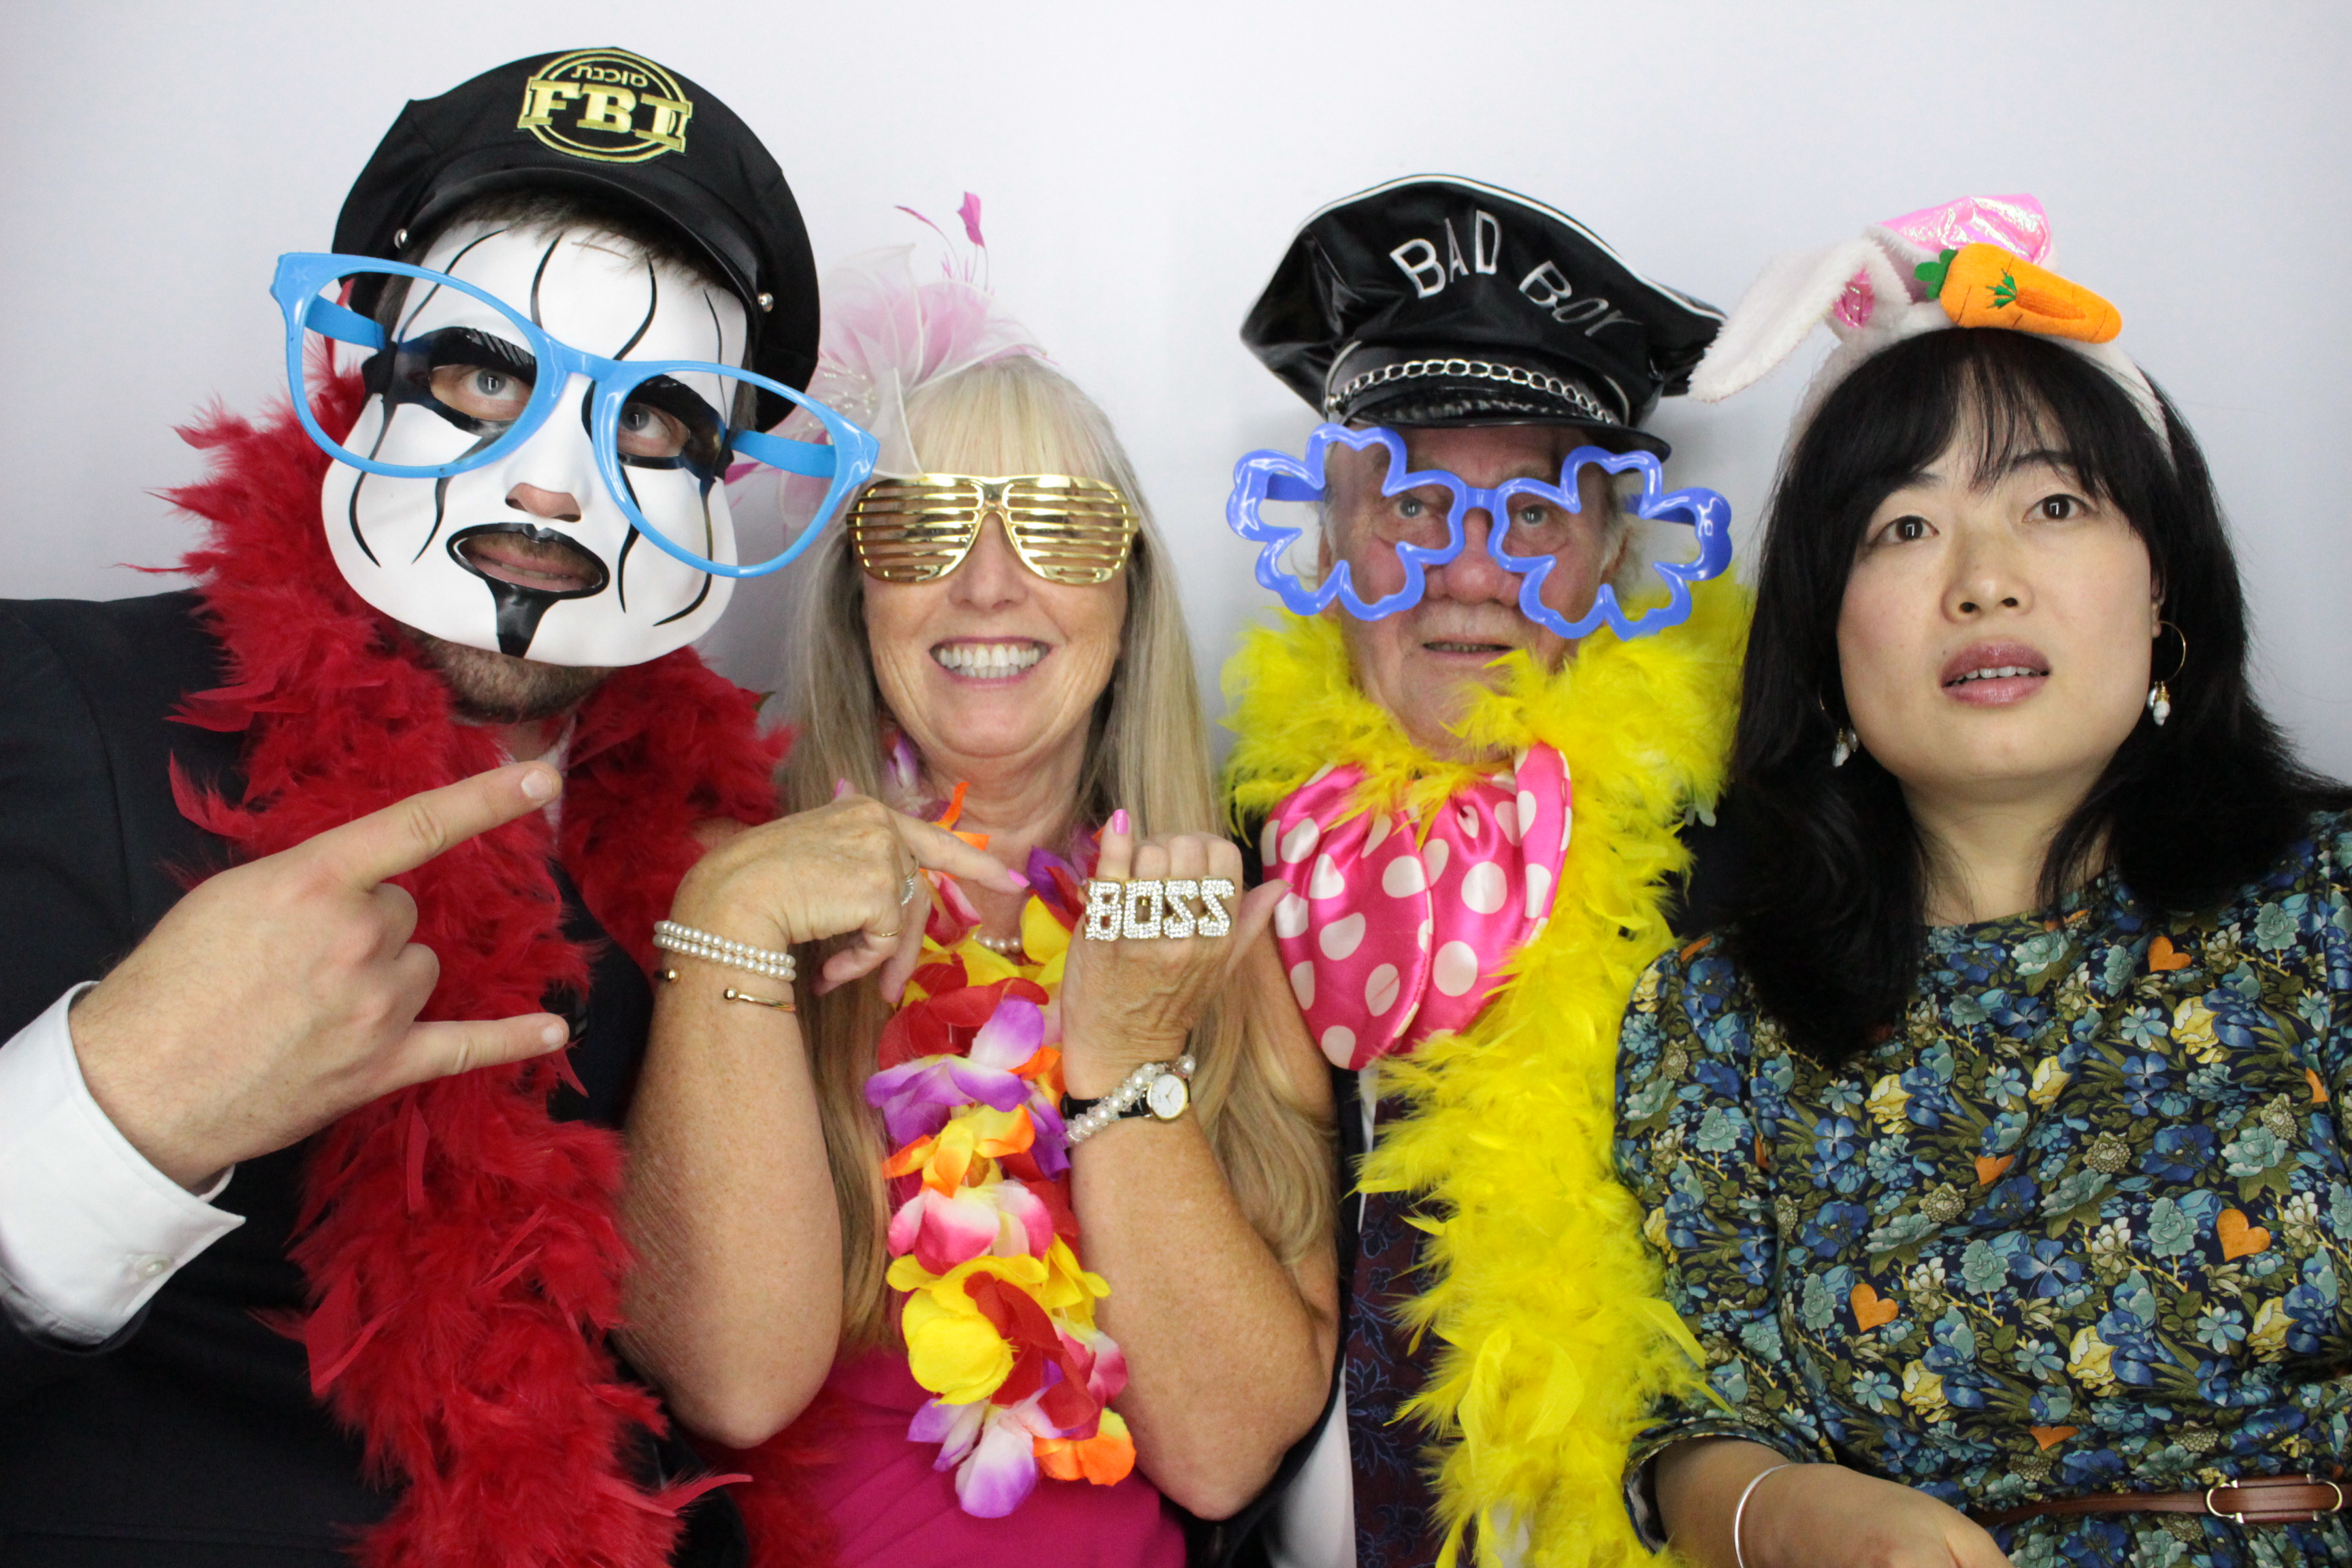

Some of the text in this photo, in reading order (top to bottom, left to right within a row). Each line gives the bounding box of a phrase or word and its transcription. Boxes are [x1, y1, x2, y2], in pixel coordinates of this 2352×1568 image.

[519, 79, 690, 150] FBI
[1389, 209, 1643, 338] BAD BOY
[1083, 876, 1235, 942] BOSS
